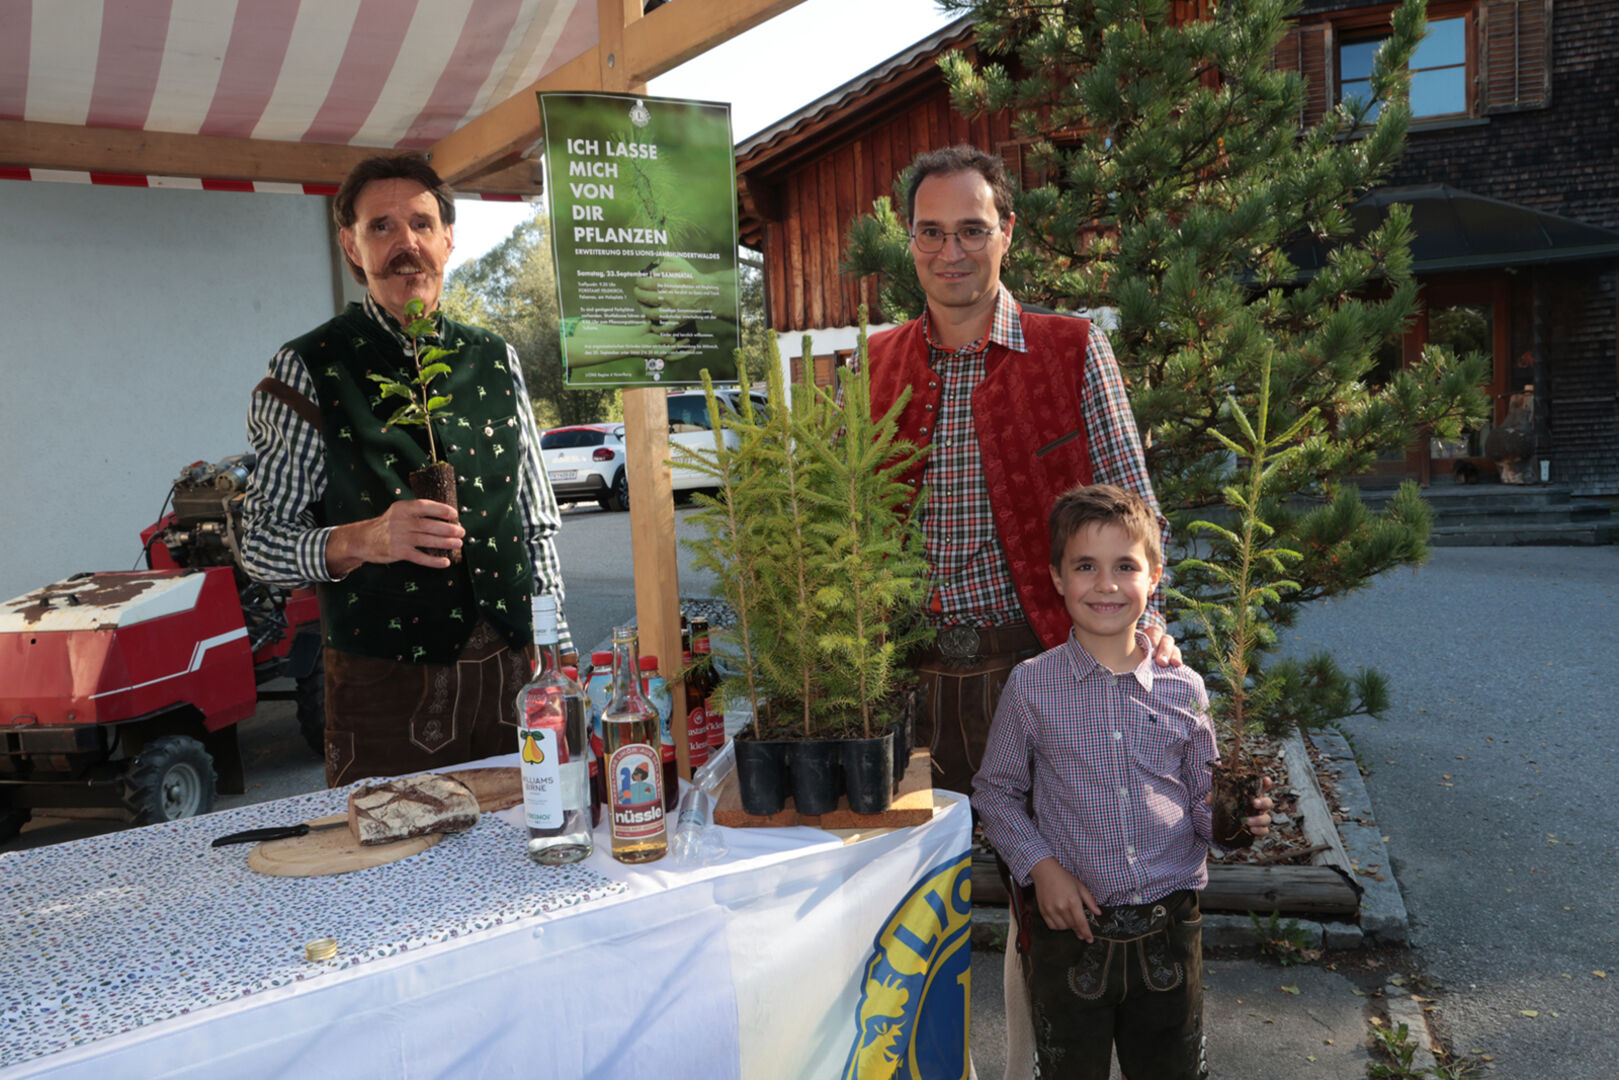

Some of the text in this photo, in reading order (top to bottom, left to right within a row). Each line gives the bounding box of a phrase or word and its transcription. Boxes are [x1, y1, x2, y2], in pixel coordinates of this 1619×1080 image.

[567, 138, 658, 160] ICH LASSE
[569, 161, 618, 178] MICH
[570, 183, 614, 200] VON
[572, 205, 604, 221] DIR
[574, 227, 668, 245] PFLANZEN
[574, 248, 621, 256] ERWEITERUNG
[615, 806, 662, 824] nüssle
